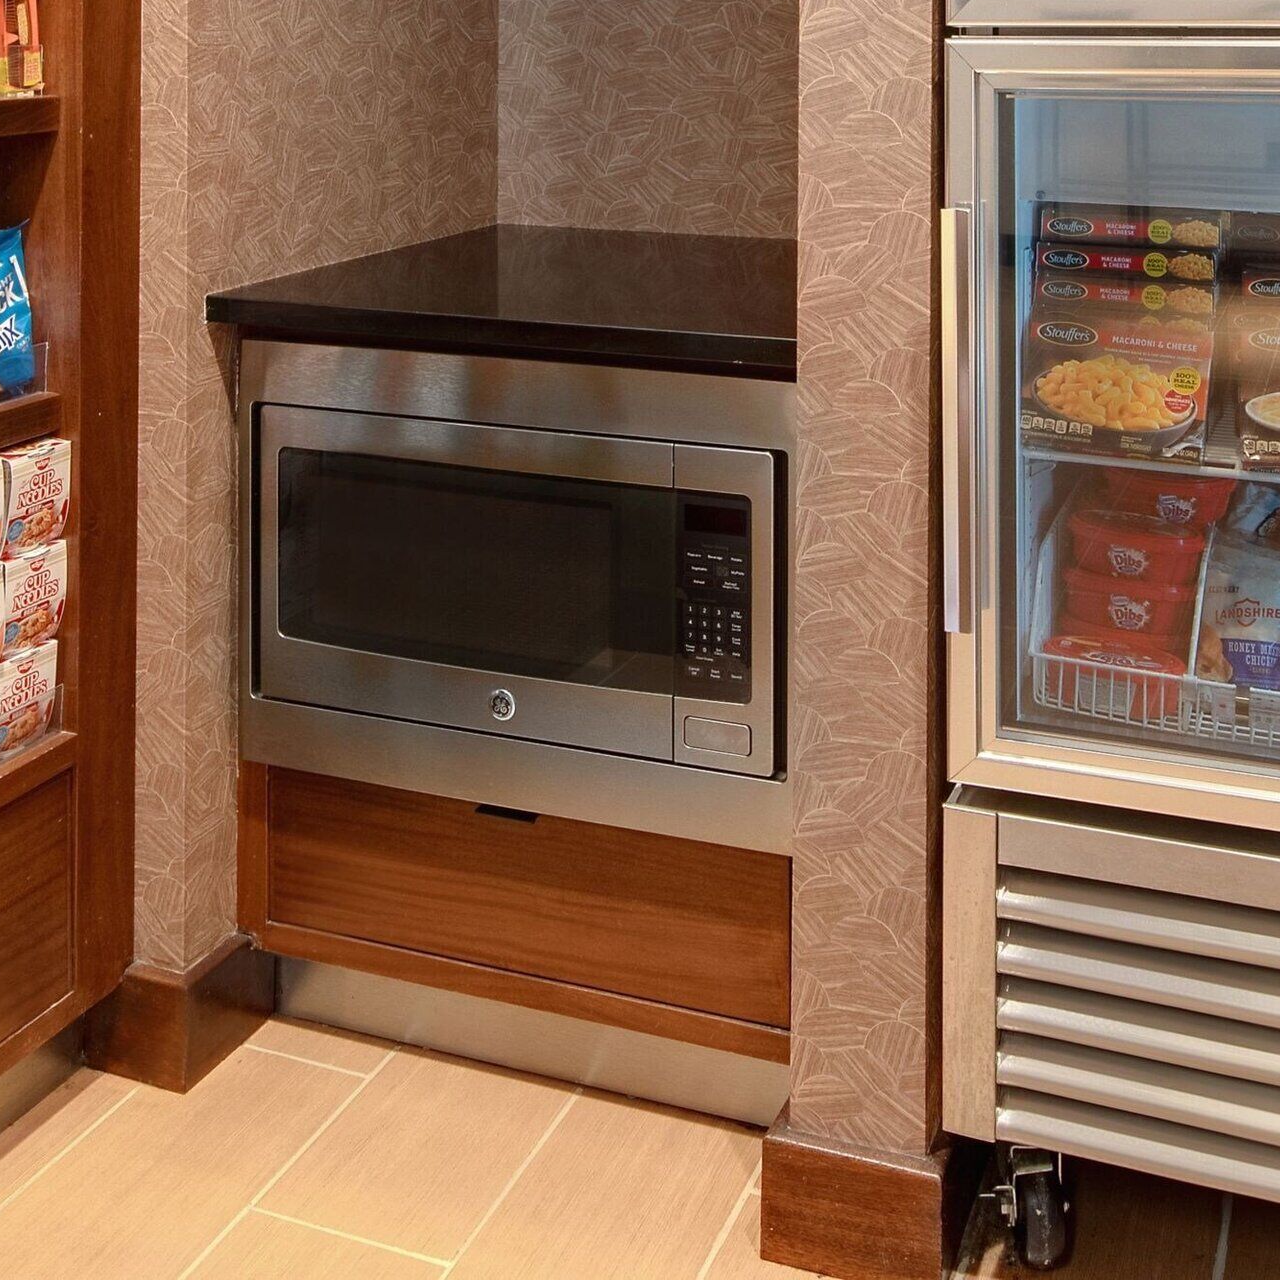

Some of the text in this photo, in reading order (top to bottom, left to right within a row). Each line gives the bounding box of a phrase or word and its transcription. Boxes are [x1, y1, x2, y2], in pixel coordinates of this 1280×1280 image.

[1043, 324, 1092, 345] Stouffer's
[1112, 335, 1198, 353] MACARONI CHEESE
[1228, 641, 1256, 654] HONEY
[11, 670, 40, 696] CUP
[0, 679, 48, 715] NOODLES
